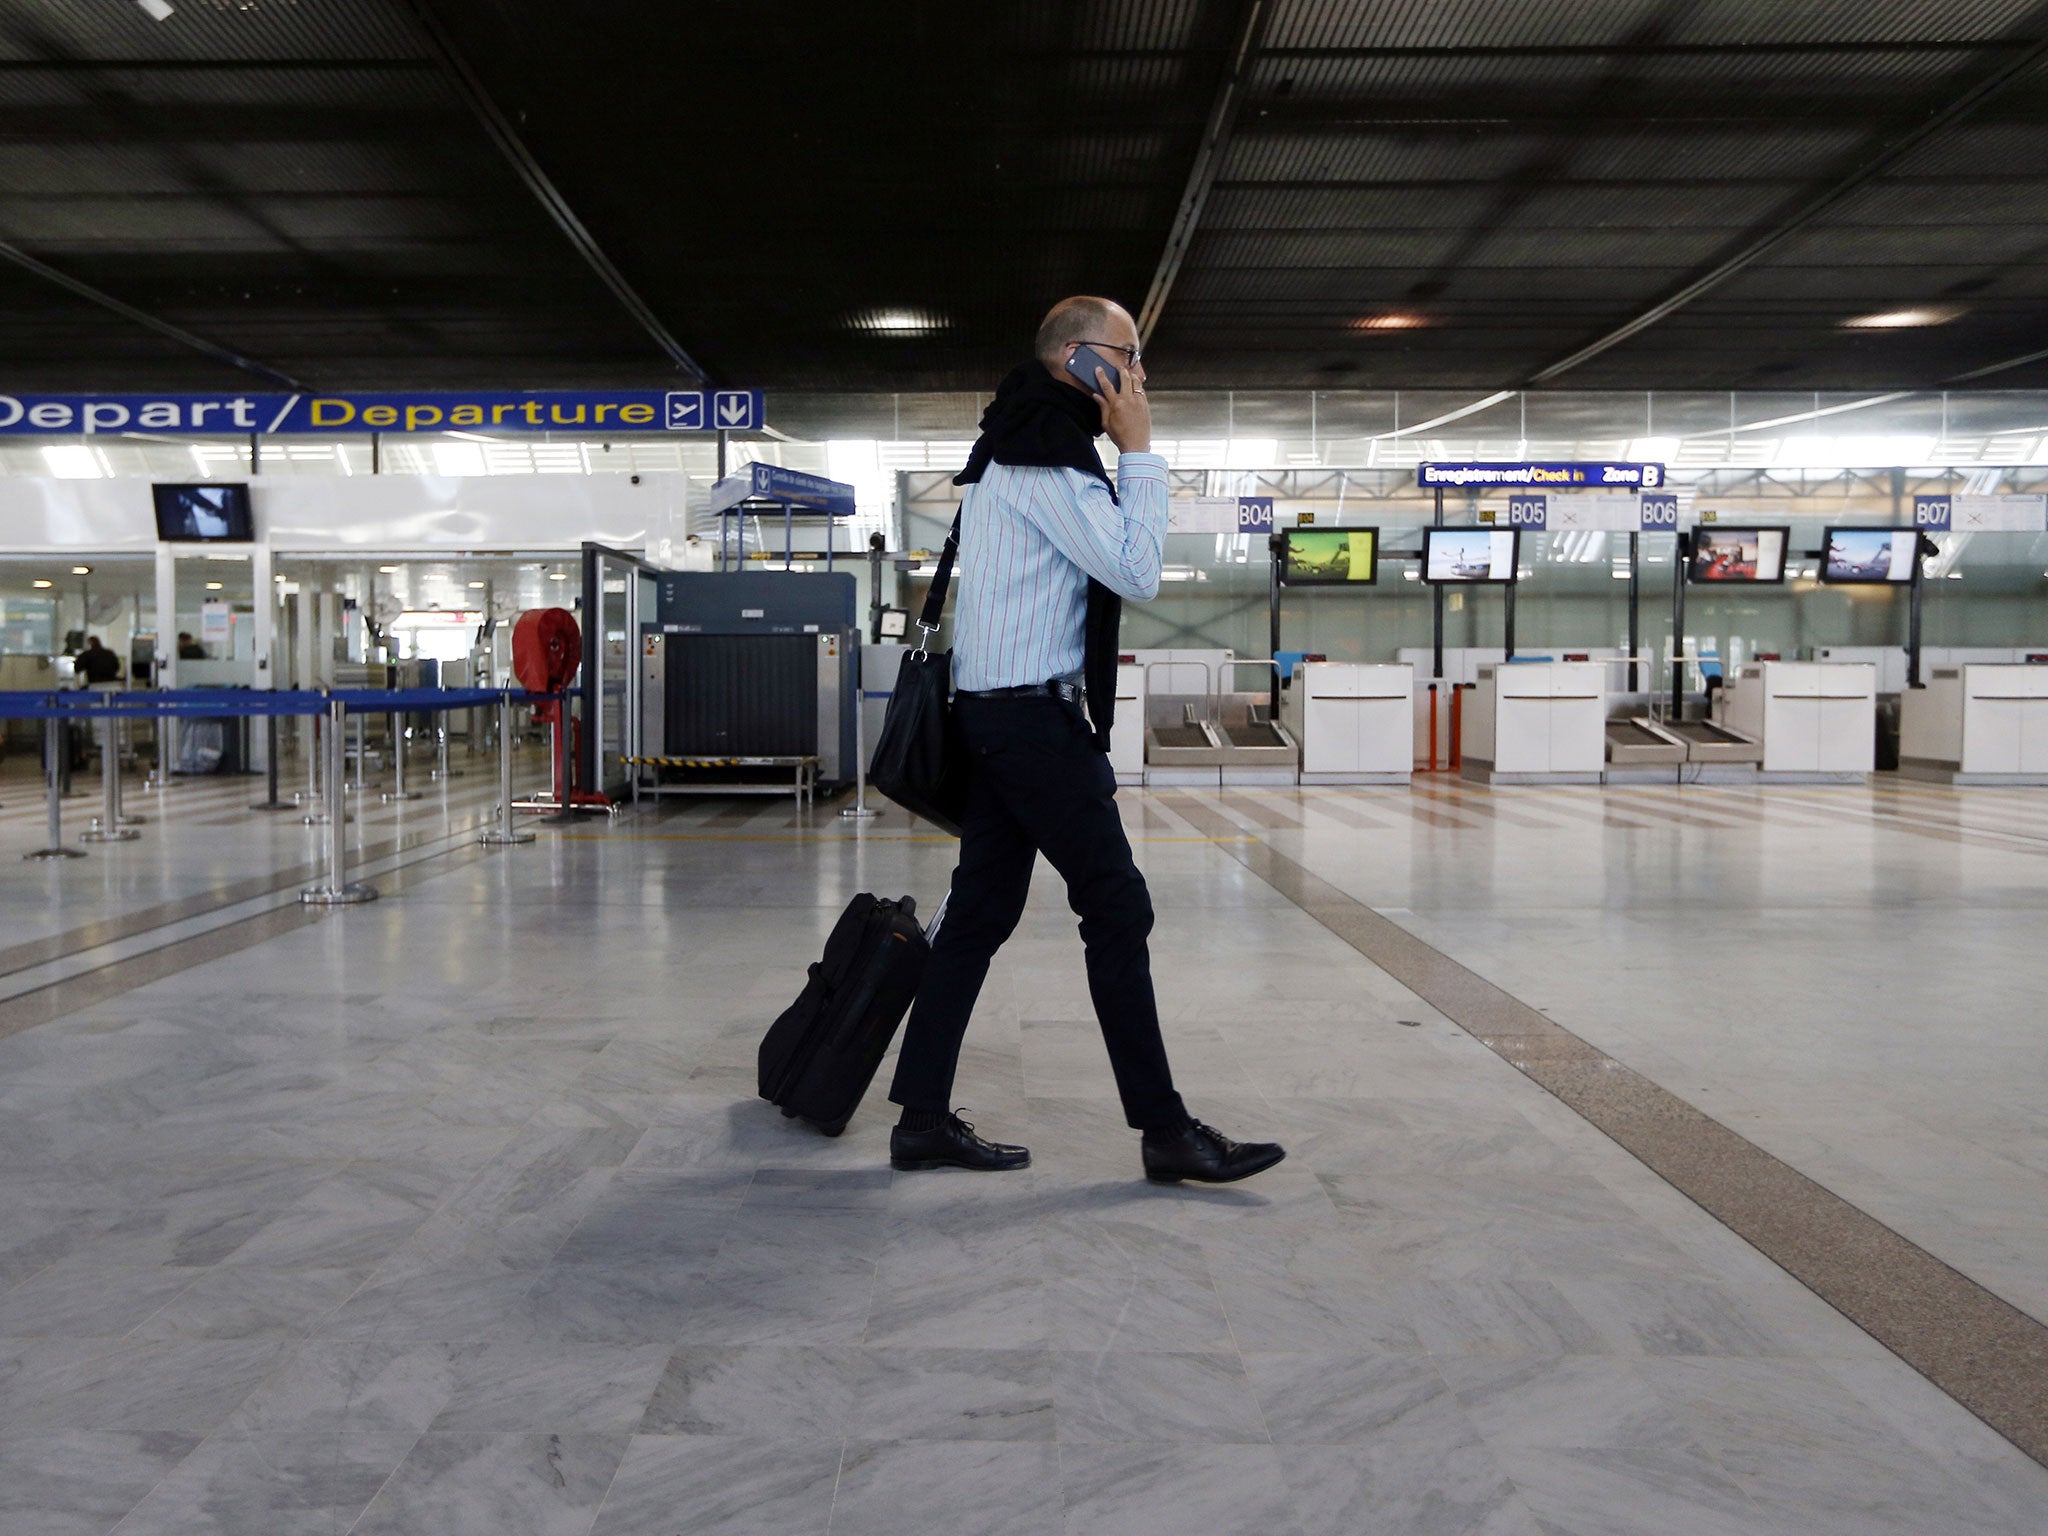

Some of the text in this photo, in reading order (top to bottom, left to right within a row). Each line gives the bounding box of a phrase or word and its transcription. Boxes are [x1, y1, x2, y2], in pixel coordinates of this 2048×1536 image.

[1602, 467, 1640, 483] Zone
[1641, 465, 1659, 487] B
[1239, 504, 1272, 525] B04
[1511, 501, 1545, 525] B05
[1642, 501, 1676, 525] B06
[1916, 502, 1950, 525] B07
